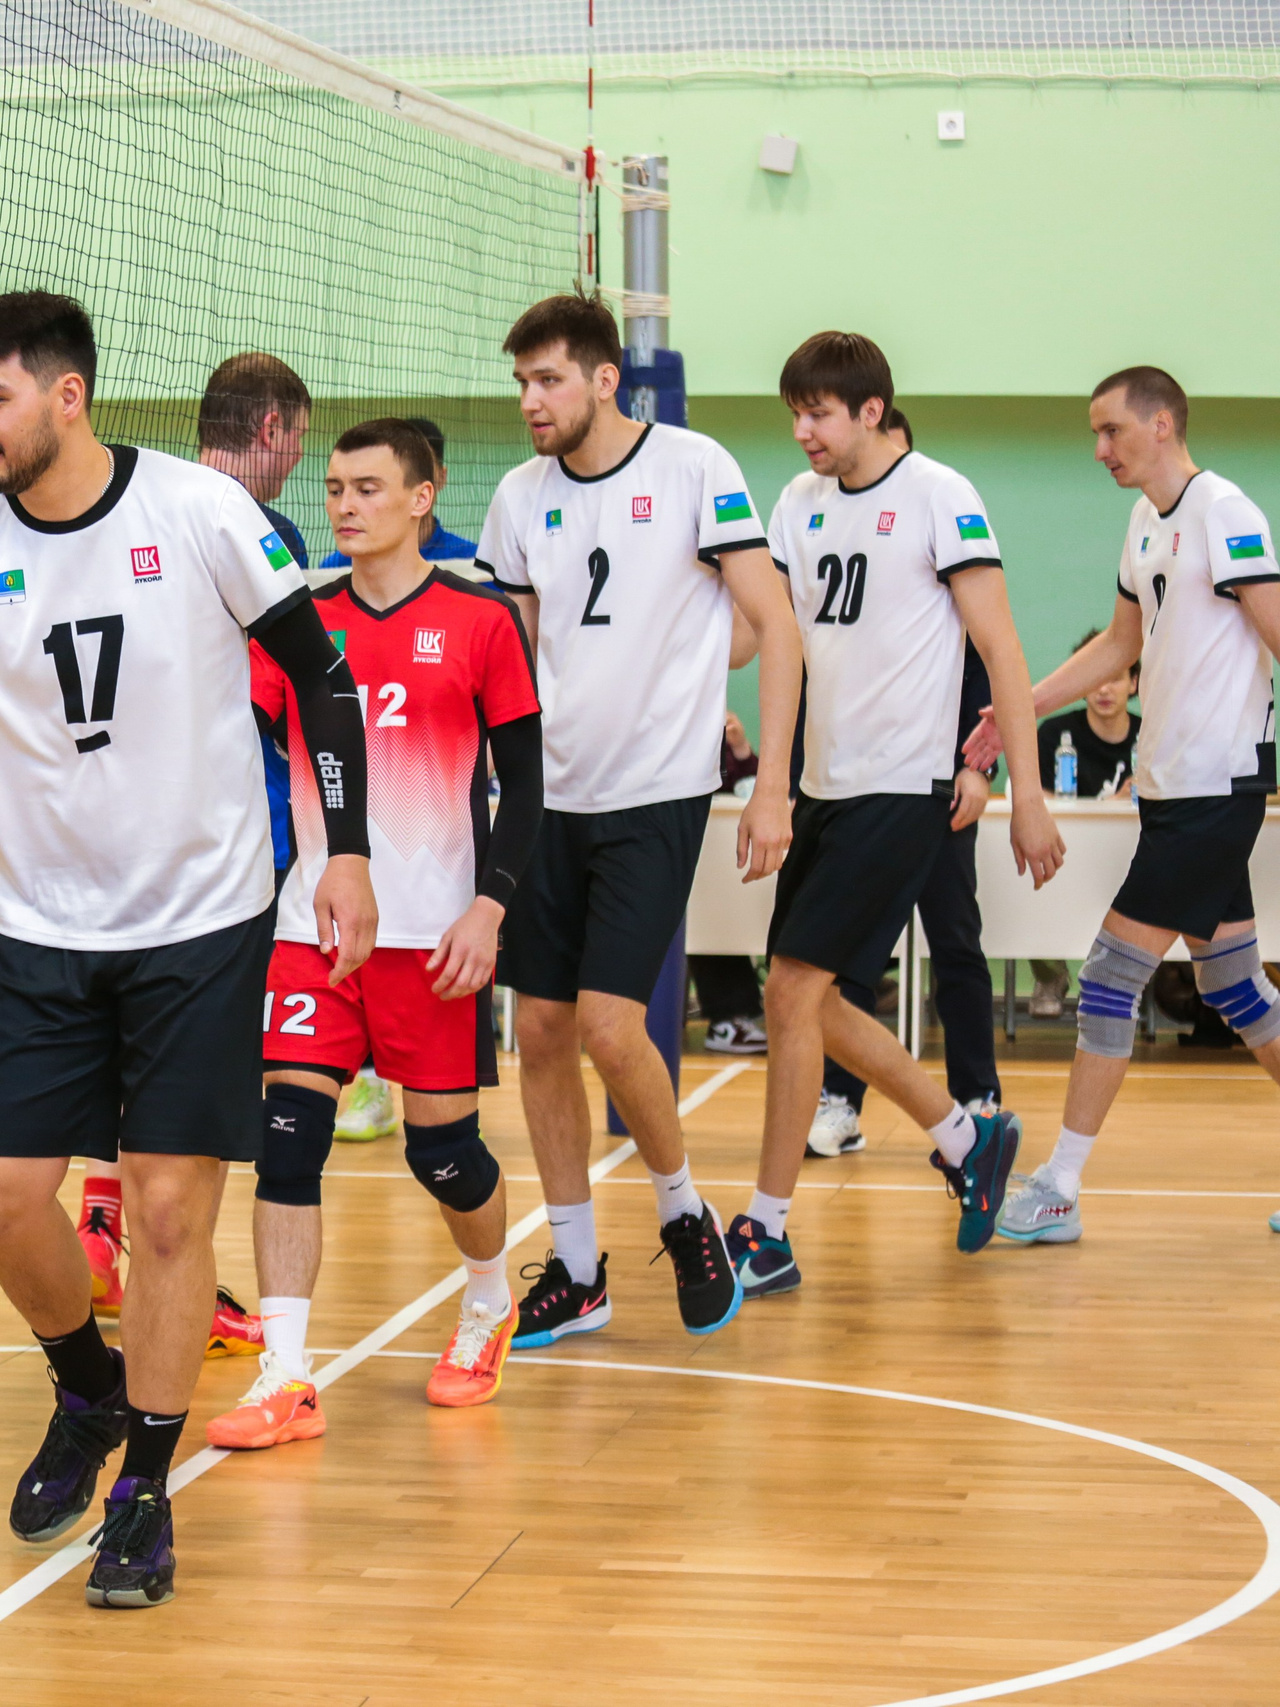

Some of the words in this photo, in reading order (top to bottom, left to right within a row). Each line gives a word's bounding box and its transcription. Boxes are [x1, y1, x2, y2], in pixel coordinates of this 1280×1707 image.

[133, 548, 160, 573] LUK
[580, 547, 610, 626] 2
[814, 553, 868, 626] 20
[42, 613, 125, 725] 17
[416, 630, 442, 654] LUK
